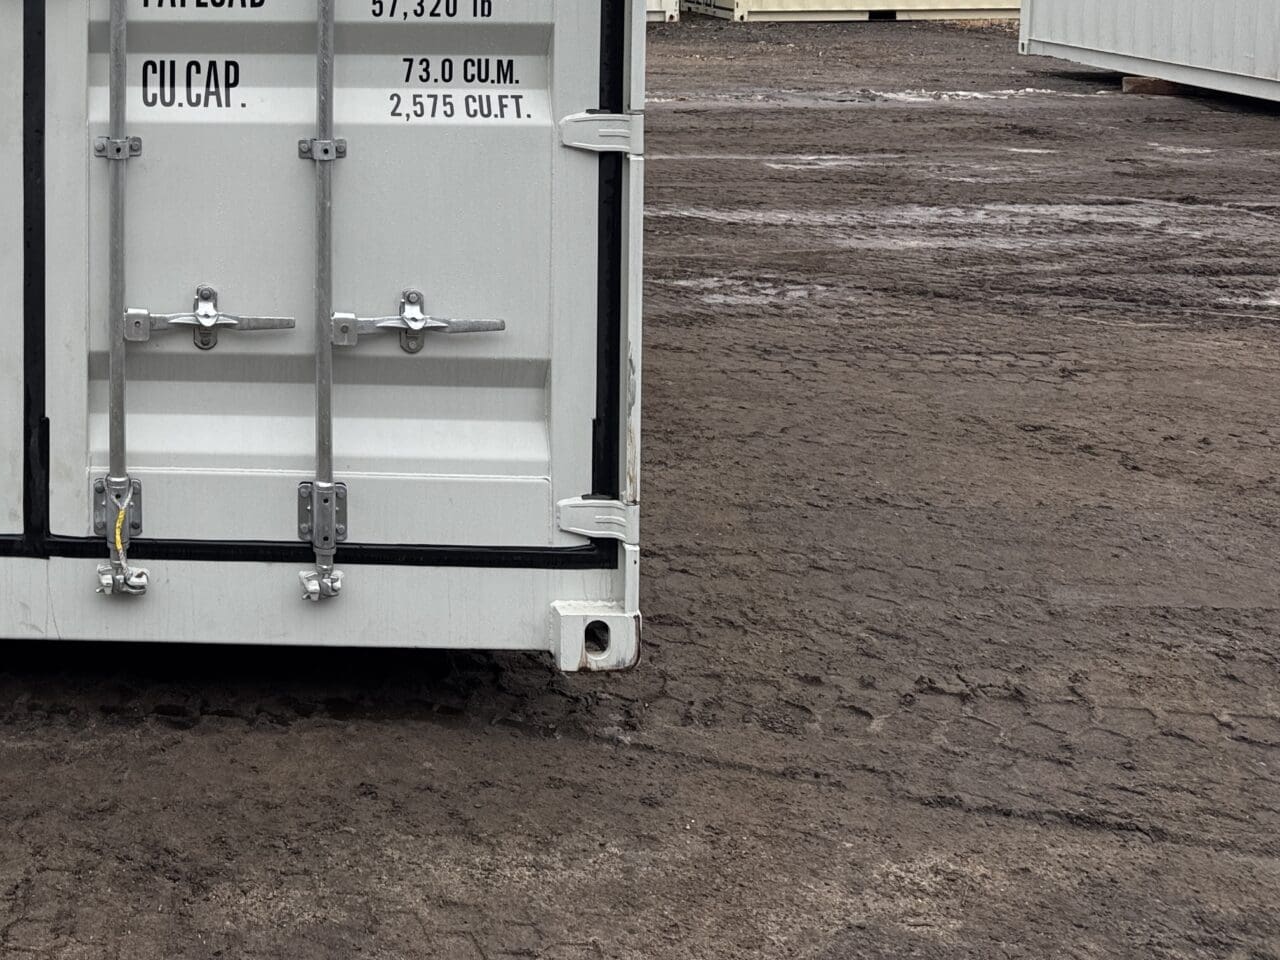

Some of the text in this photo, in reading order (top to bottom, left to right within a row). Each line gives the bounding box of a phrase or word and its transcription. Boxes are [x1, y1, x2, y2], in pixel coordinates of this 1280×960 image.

[142, 60, 247, 108] CU.CAP.
[403, 58, 520, 84] 73.0 CU.M.
[390, 93, 532, 121] 2,575 CU.FT.
